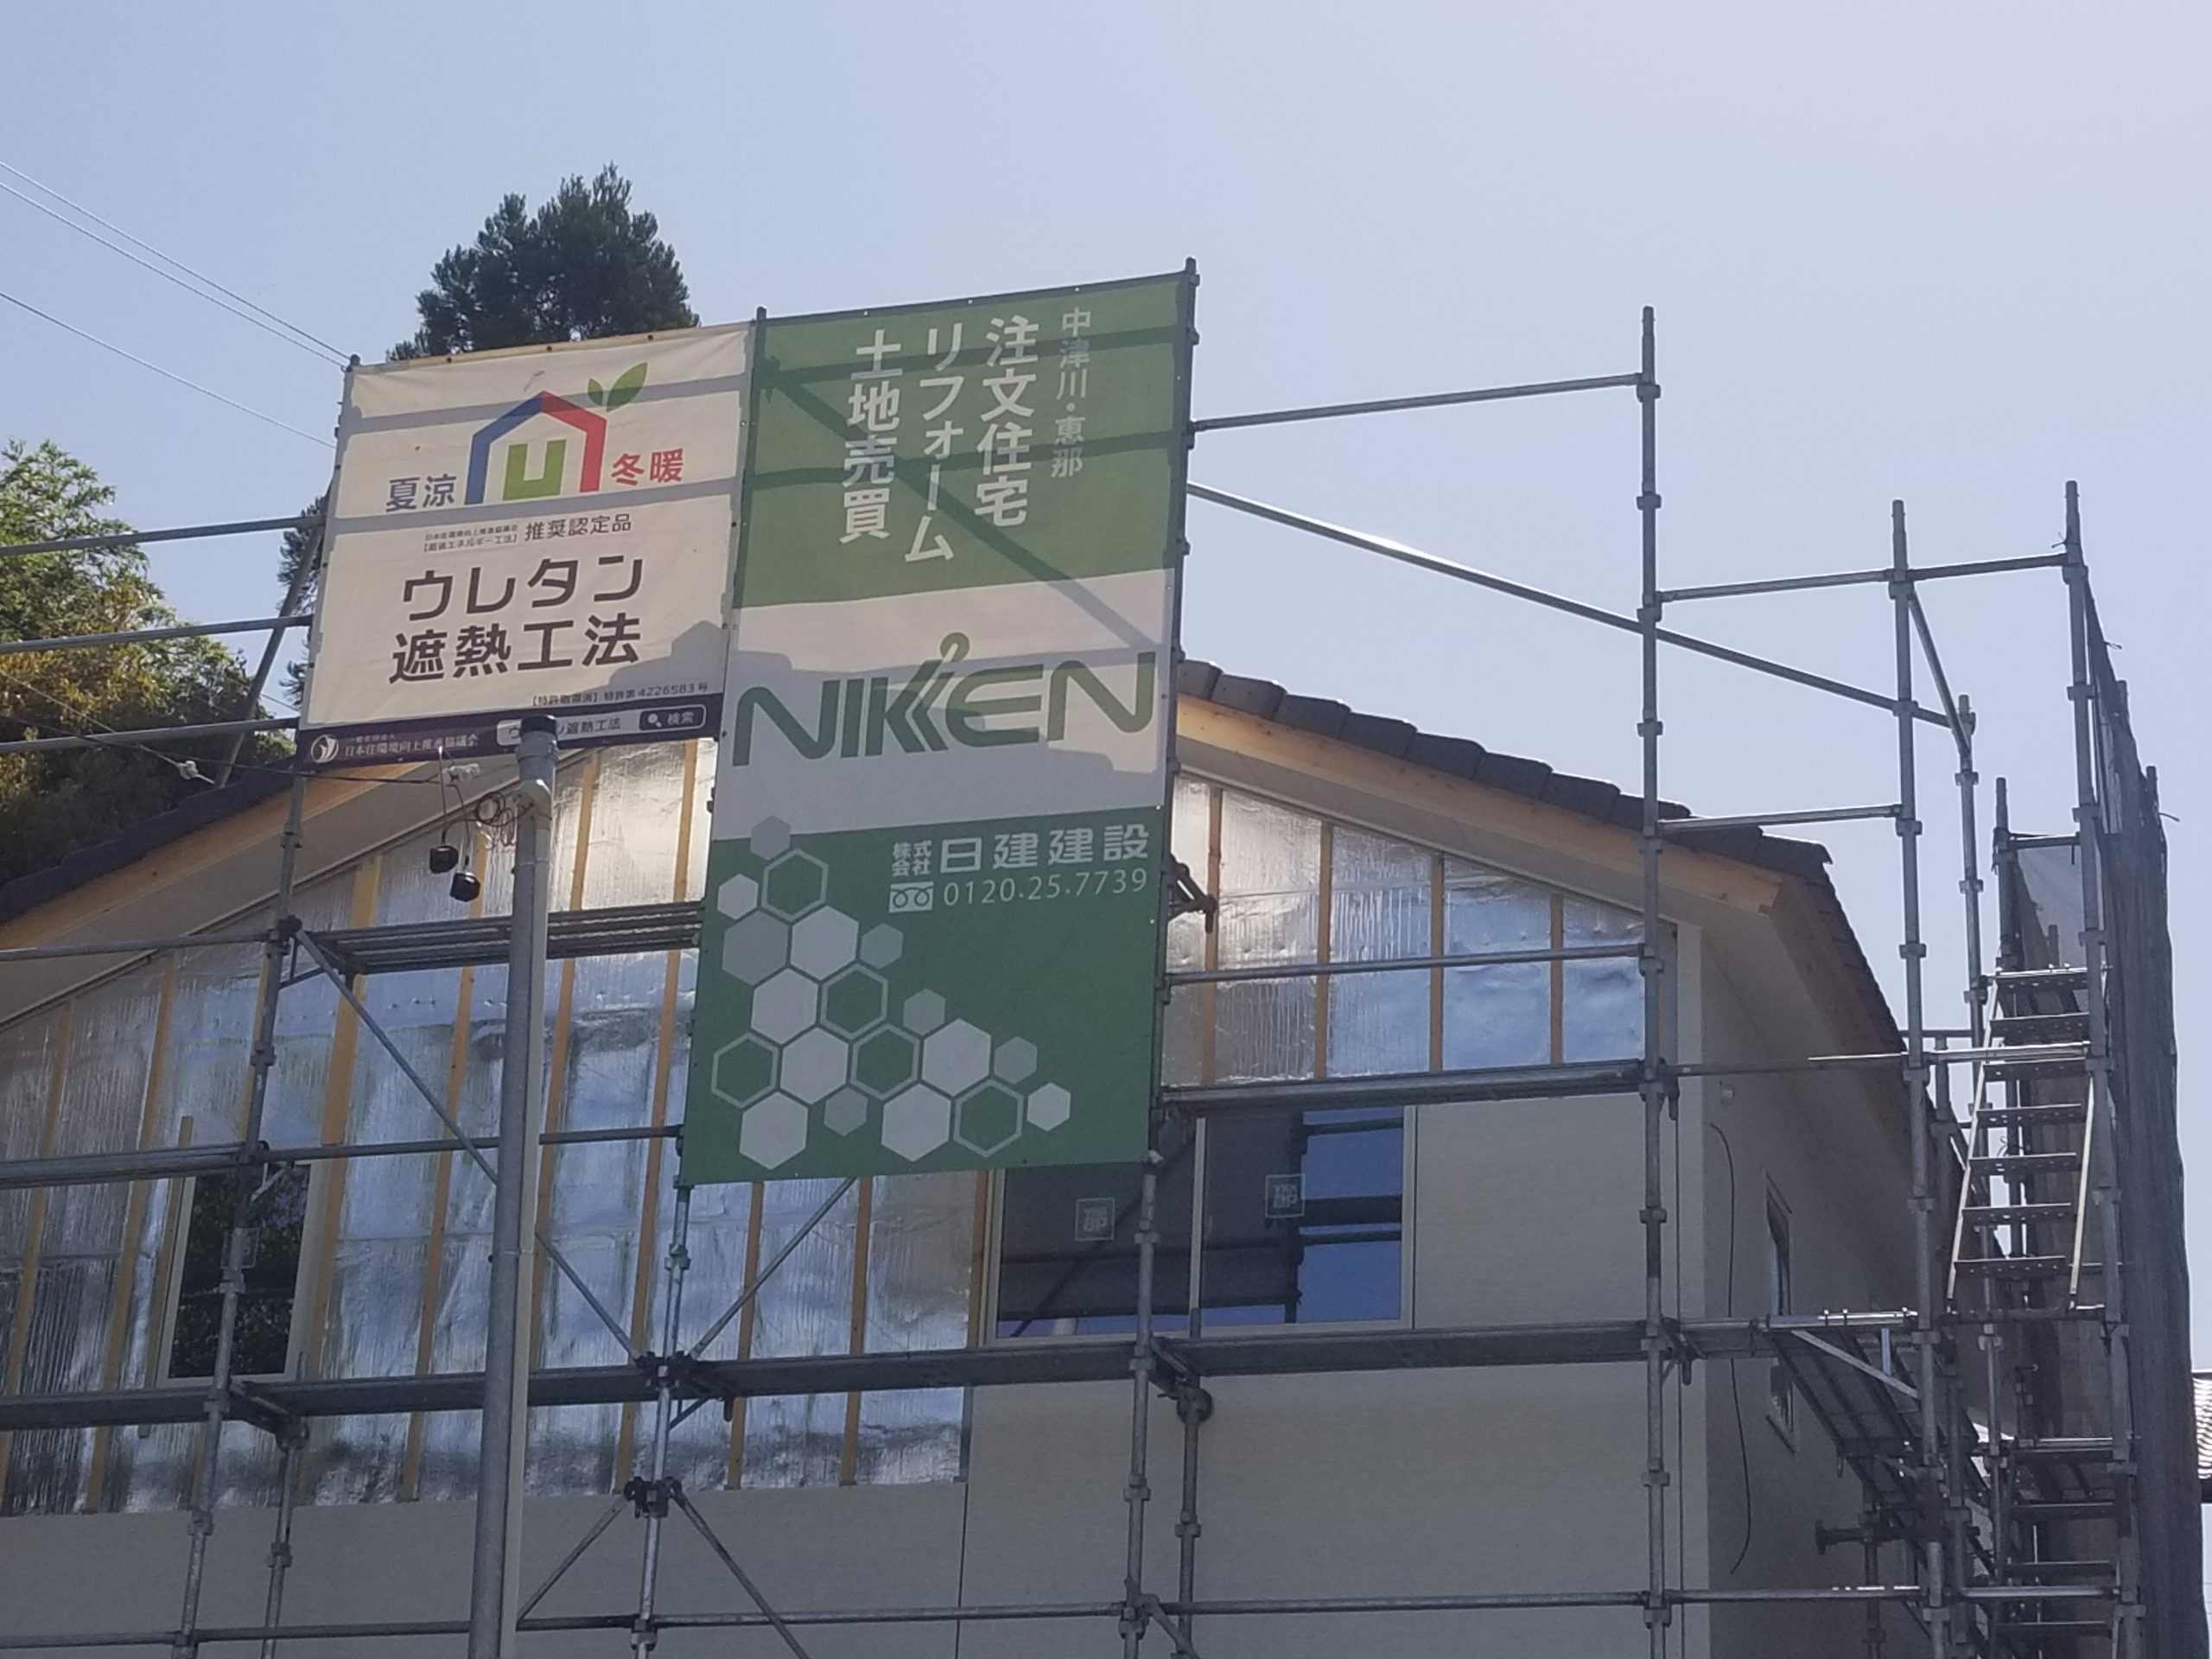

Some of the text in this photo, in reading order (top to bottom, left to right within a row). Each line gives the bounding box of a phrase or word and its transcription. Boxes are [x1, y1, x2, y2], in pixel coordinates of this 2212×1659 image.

[839, 329, 903, 544] 土地売買
[905, 322, 964, 563] リフォーム
[975, 315, 1039, 527] 注文住宅
[385, 474, 457, 512] 夏涼
[611, 448, 684, 486] 冬暖
[524, 513, 632, 542] 推奨認定品
[402, 555, 643, 621] ウレタン
[389, 612, 641, 683] 遮熱工法
[940, 823, 1150, 874] 日建建設
